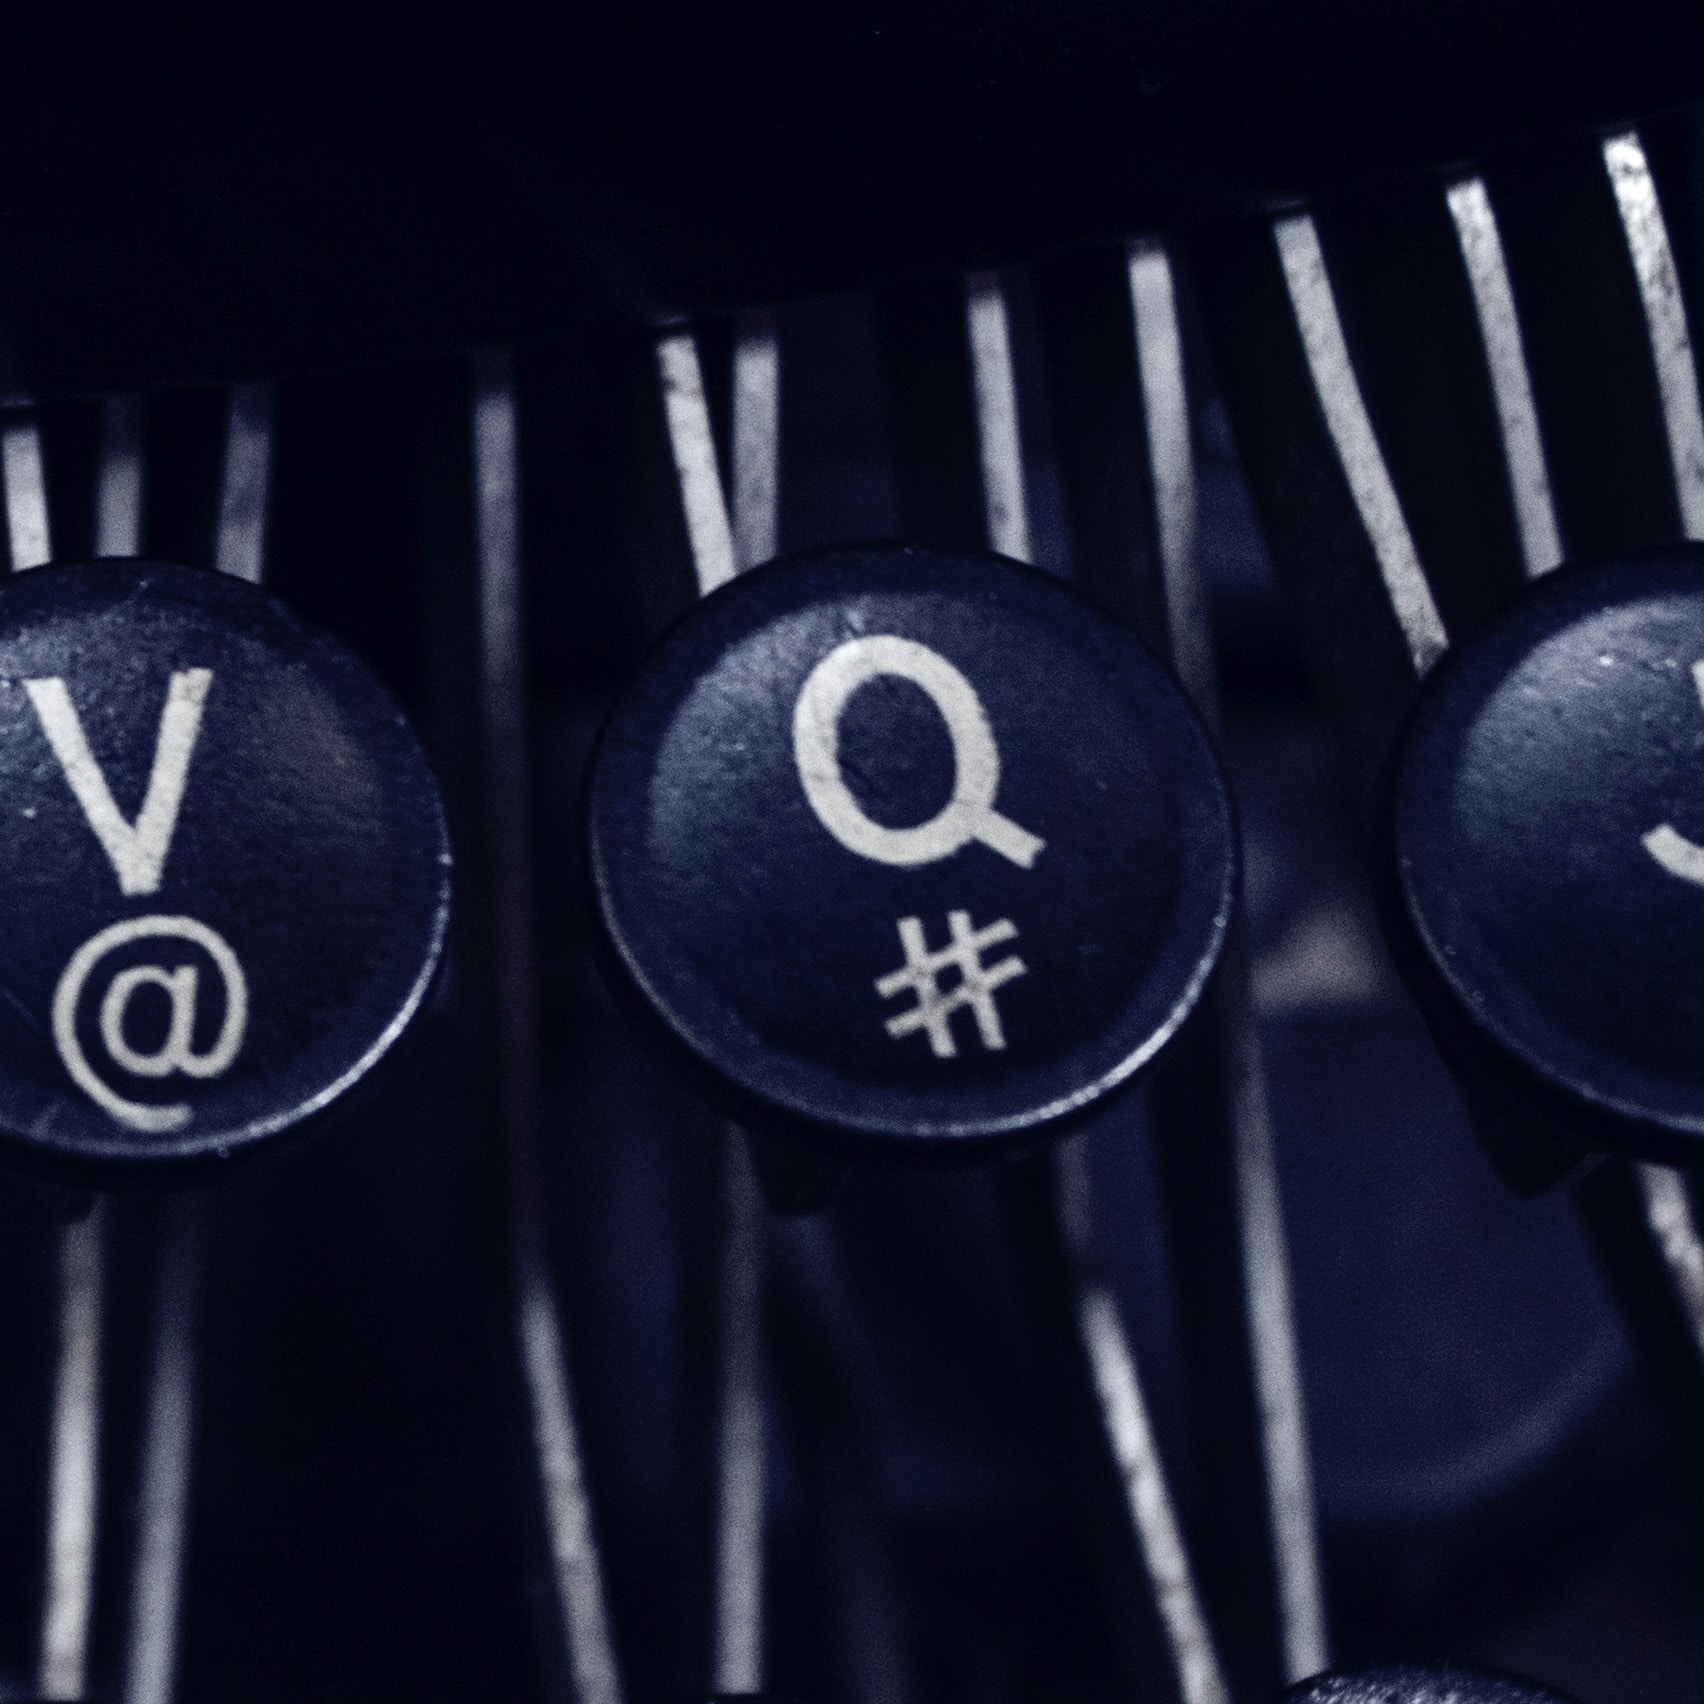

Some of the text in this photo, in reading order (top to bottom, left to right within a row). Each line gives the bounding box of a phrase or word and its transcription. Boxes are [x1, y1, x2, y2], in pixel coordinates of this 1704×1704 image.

[22, 668, 212, 895] V
[791, 633, 1046, 869] Q
[51, 912, 248, 1132] @
[873, 908, 1028, 1059] #
